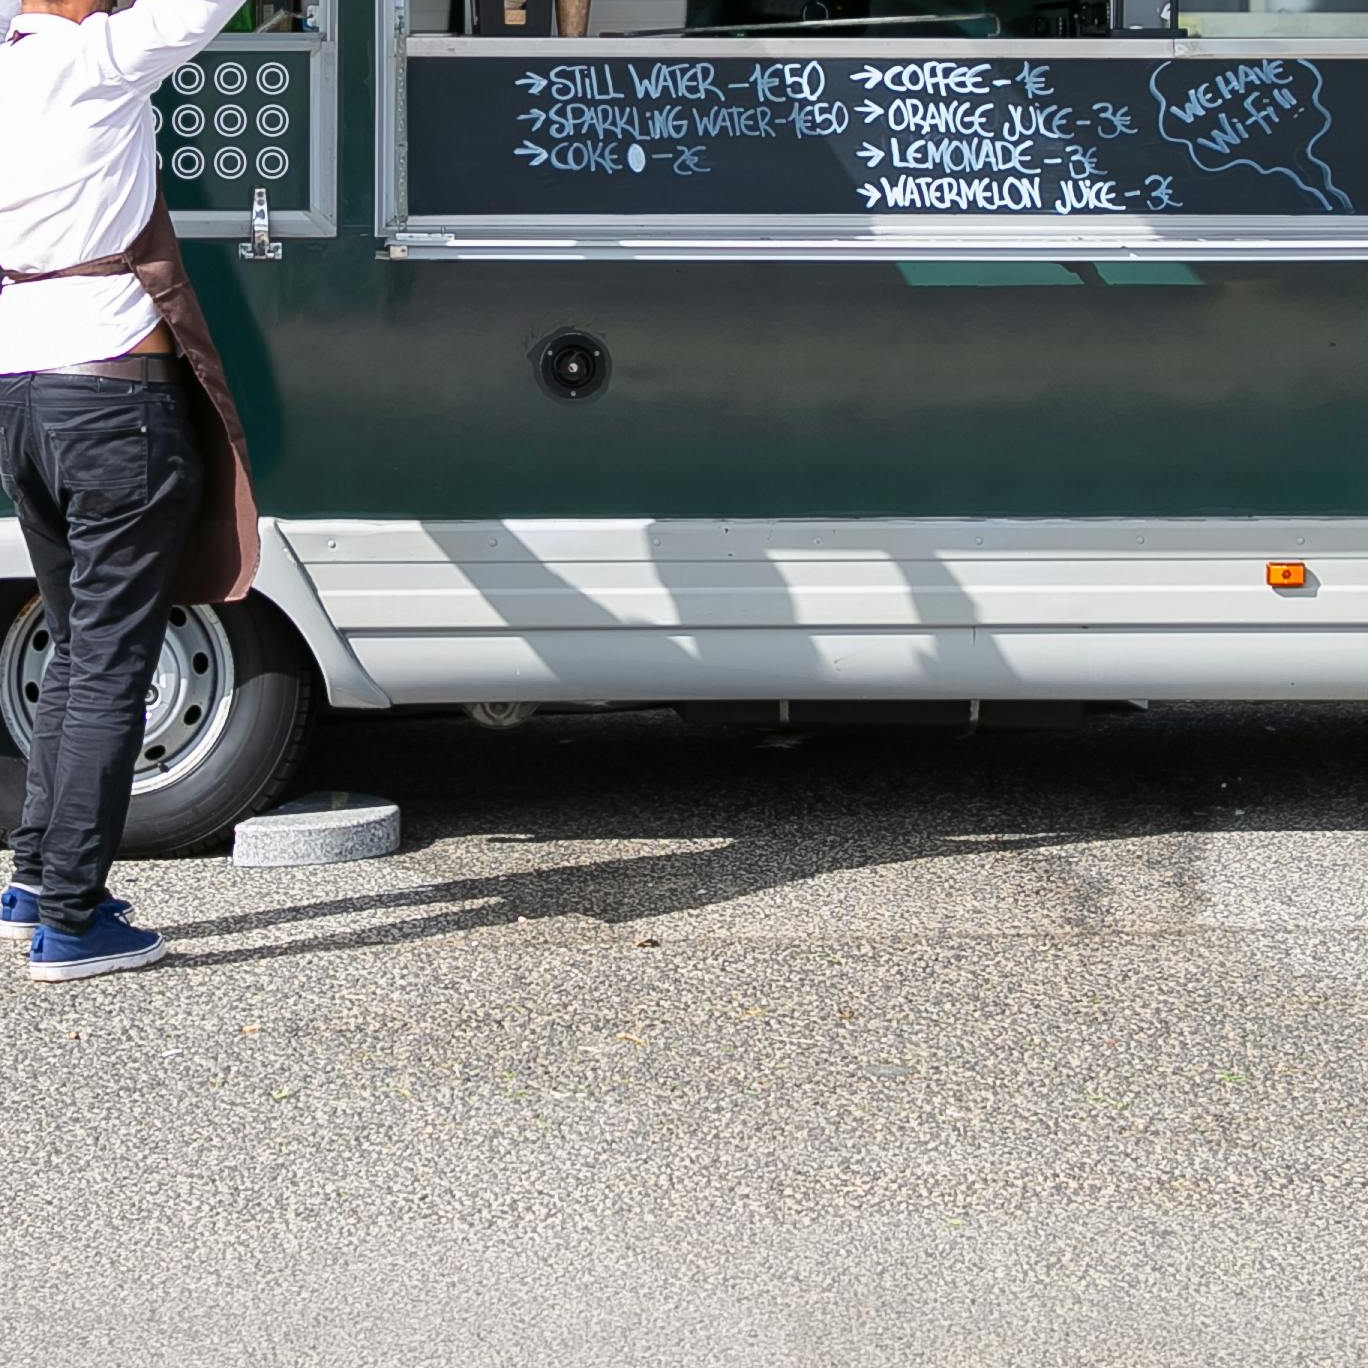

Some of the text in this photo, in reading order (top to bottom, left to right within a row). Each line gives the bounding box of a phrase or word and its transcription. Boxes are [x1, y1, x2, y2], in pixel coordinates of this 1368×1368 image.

[628, 63, 725, 102] WATER
[883, 61, 992, 97] COFFEE
[1170, 59, 1293, 124] WE HAVE
[692, 105, 776, 138] WATER
[888, 99, 995, 137] ORANGE
[550, 142, 623, 174] COKE
[890, 136, 1042, 174] LEMONADE
[880, 175, 1042, 209] WATERMELON
